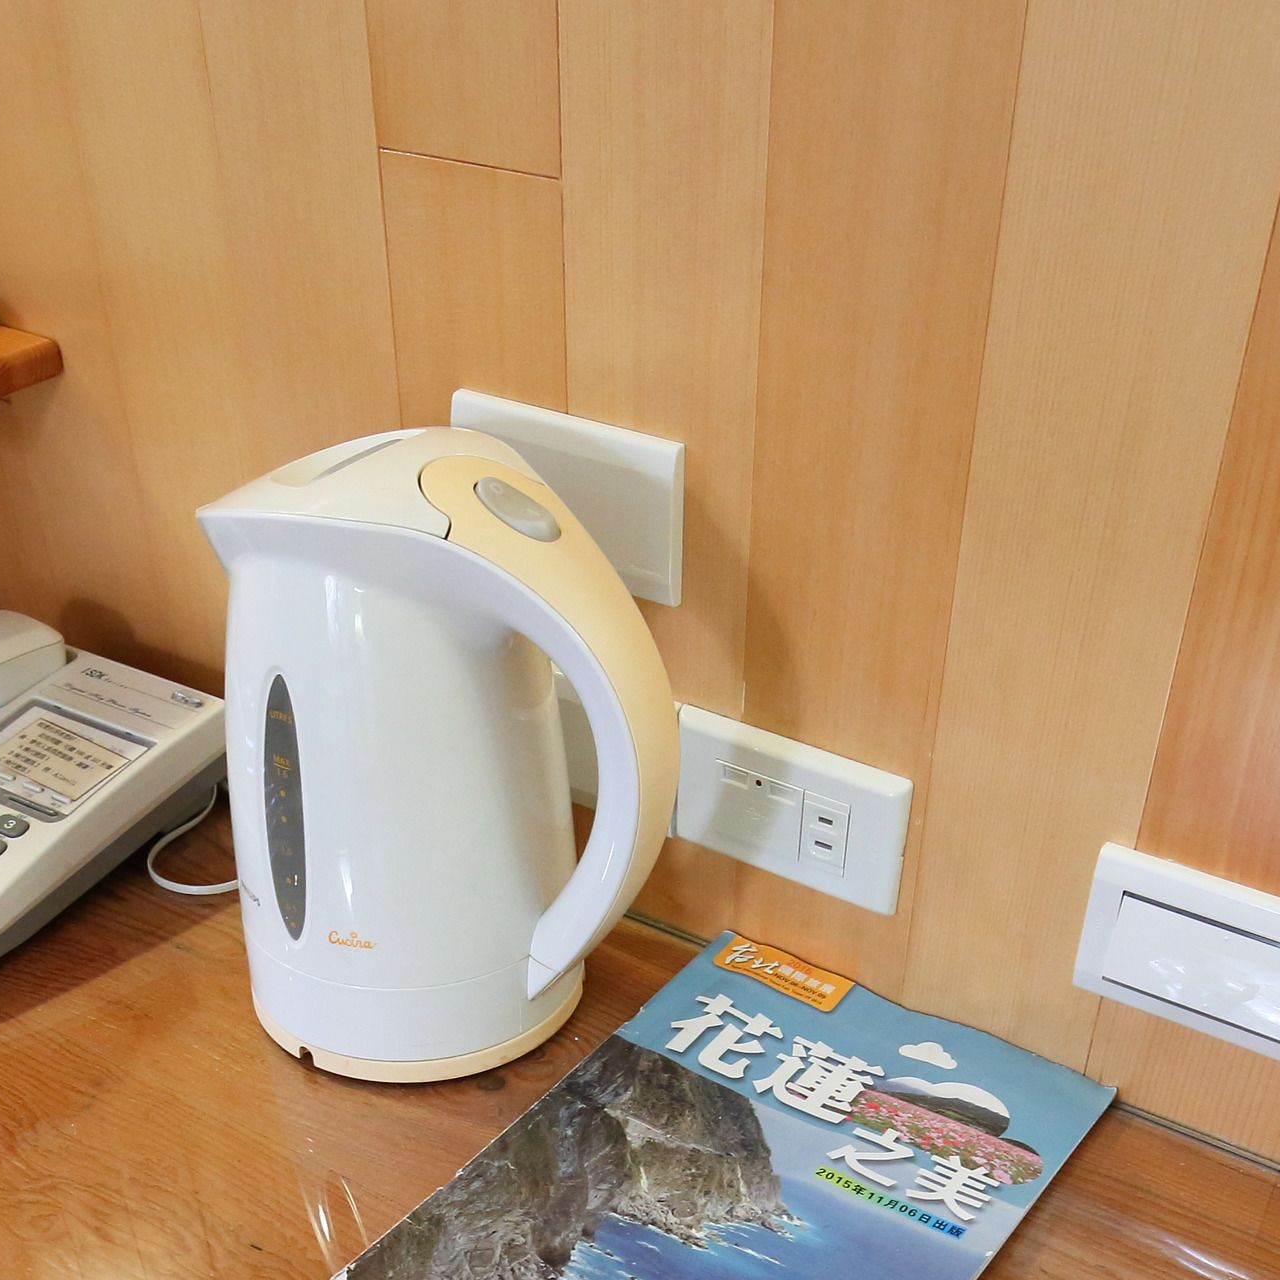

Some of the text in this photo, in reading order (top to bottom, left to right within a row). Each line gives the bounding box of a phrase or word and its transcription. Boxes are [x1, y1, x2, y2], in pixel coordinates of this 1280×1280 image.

[328, 930, 375, 950] Cucina
[665, 993, 886, 1124] 花蓮
[815, 1166, 965, 1238] 2015年11月06日出版
[827, 1125, 1001, 1222] 之美
